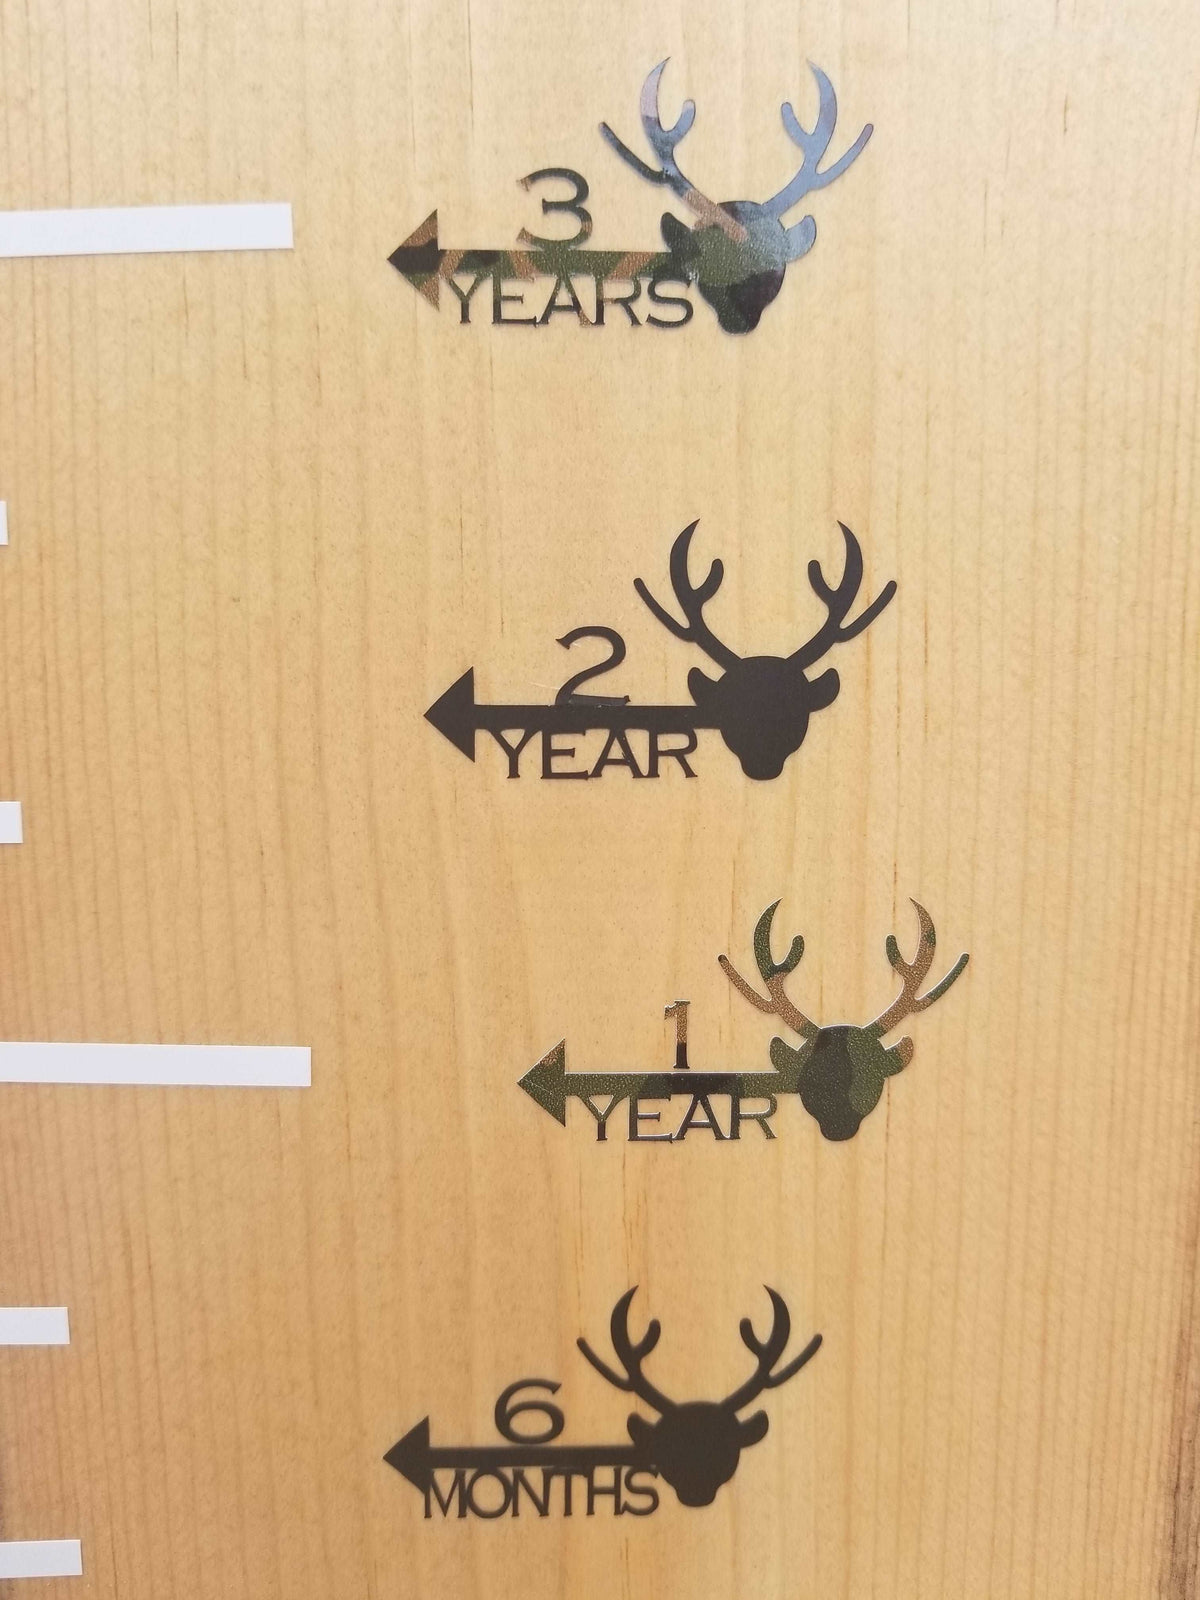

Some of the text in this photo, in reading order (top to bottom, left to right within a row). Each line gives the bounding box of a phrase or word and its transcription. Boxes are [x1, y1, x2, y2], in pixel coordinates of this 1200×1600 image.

[515, 168, 593, 248] 3
[447, 273, 695, 328] YEARS
[556, 626, 631, 707] 2
[485, 728, 698, 780] YEAR
[664, 1000, 690, 1069] 1
[577, 1094, 778, 1143] YEAR
[494, 1378, 565, 1445] 6
[424, 1467, 660, 1519] MONTHS
